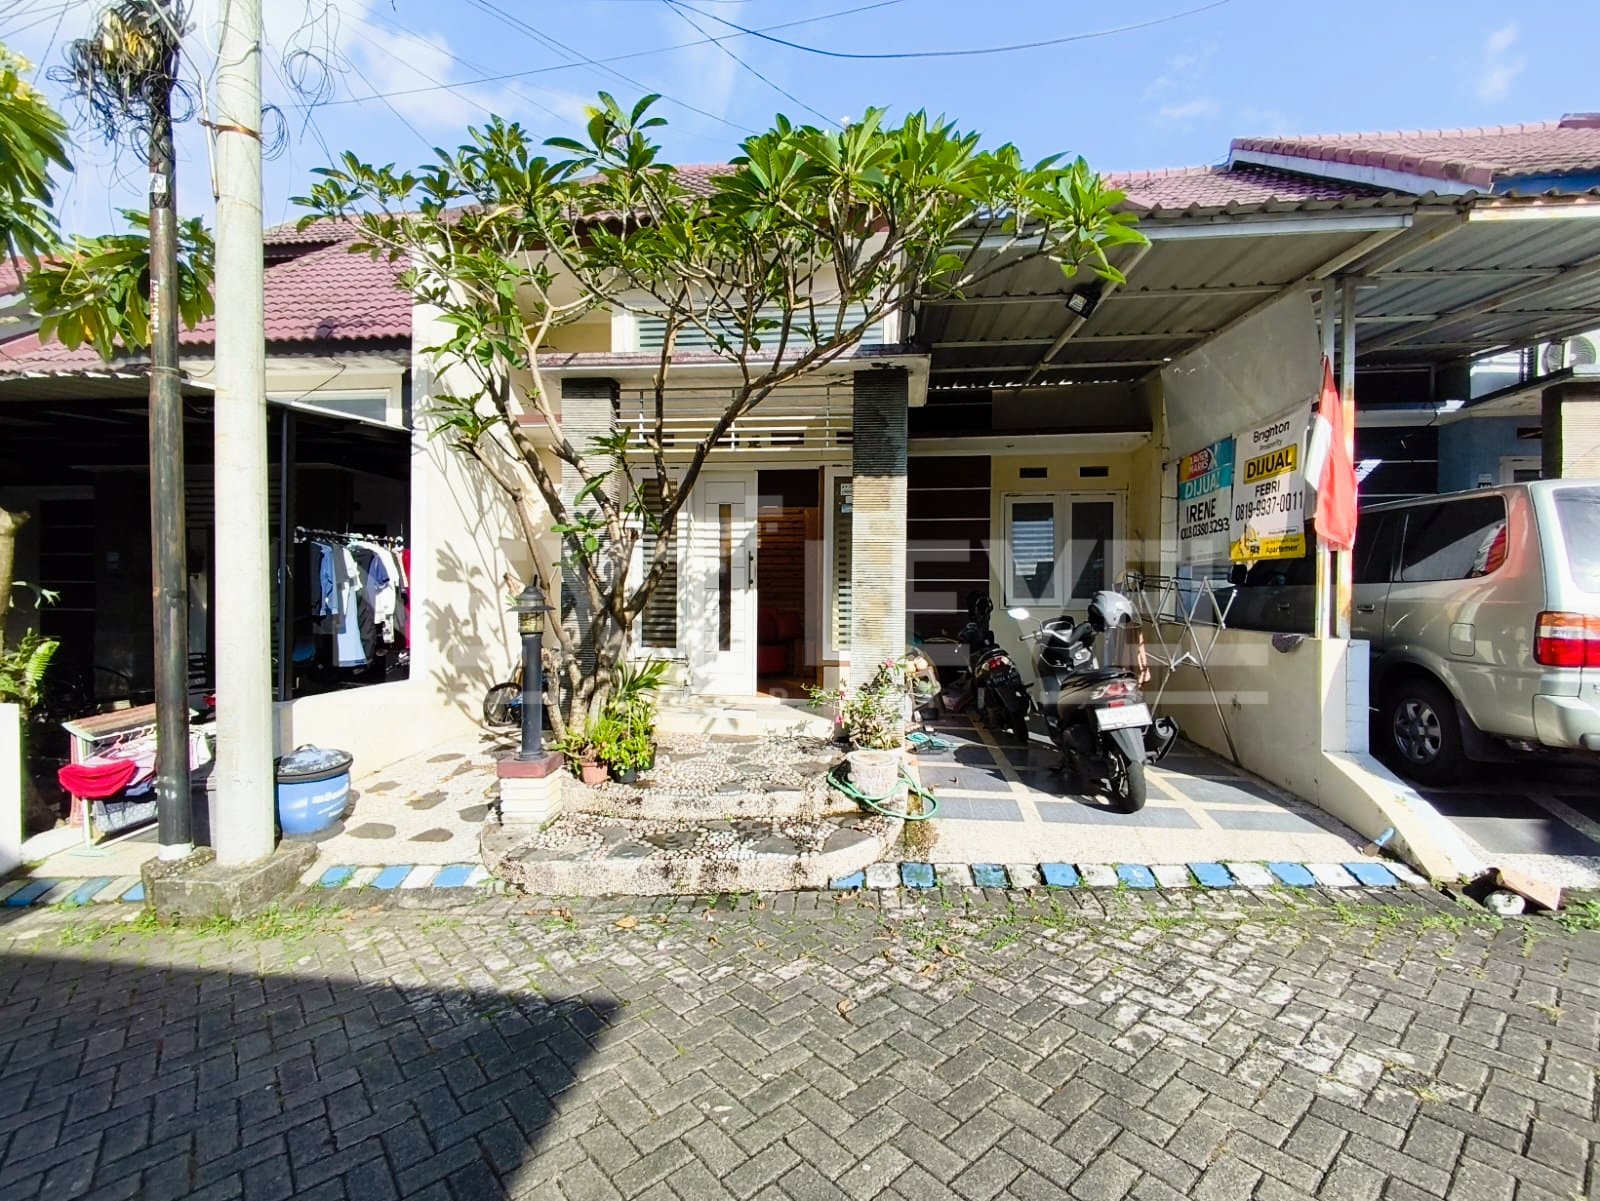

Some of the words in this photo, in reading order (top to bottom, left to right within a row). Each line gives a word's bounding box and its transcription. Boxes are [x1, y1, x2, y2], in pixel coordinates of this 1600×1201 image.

[1253, 420, 1290, 443] Brighton
[1247, 450, 1292, 478] DIJUAL
[1255, 480, 1280, 497] FEBRI
[1186, 498, 1216, 524] IRENE
[1235, 490, 1303, 521] 0819-9937-0011
